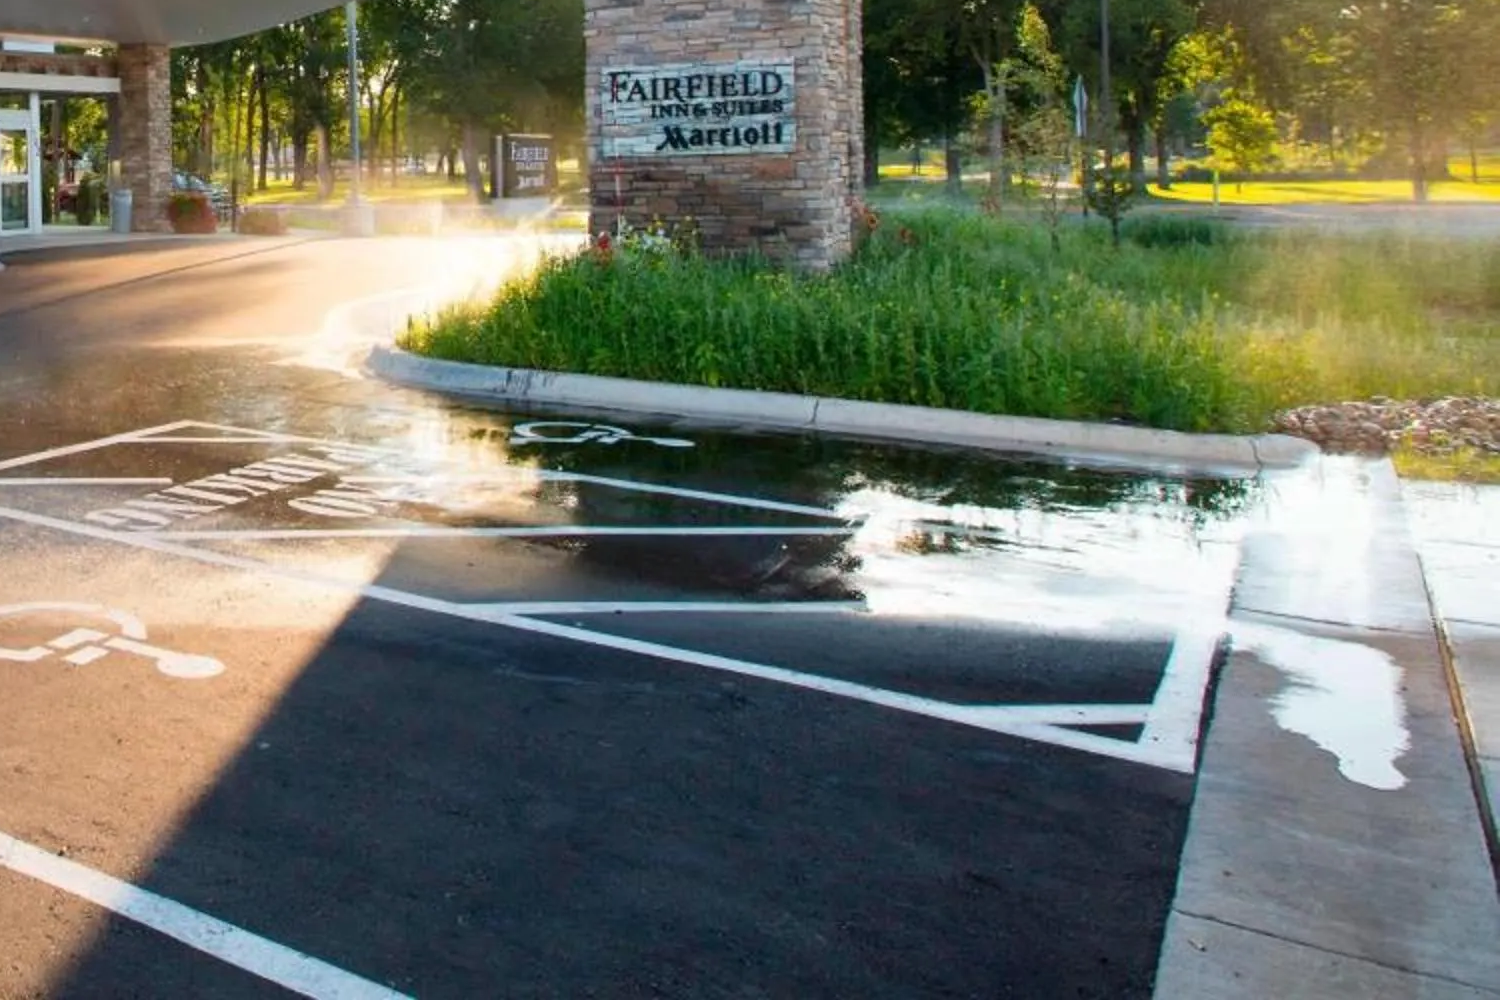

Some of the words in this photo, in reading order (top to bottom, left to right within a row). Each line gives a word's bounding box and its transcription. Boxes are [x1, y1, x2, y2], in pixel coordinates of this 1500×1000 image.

[607, 71, 783, 102] FAIRFIELD
[650, 103, 689, 118] INN
[711, 99, 783, 117] SUITES
[656, 121, 783, 150] Marriott
[84, 446, 382, 531] PARKING
